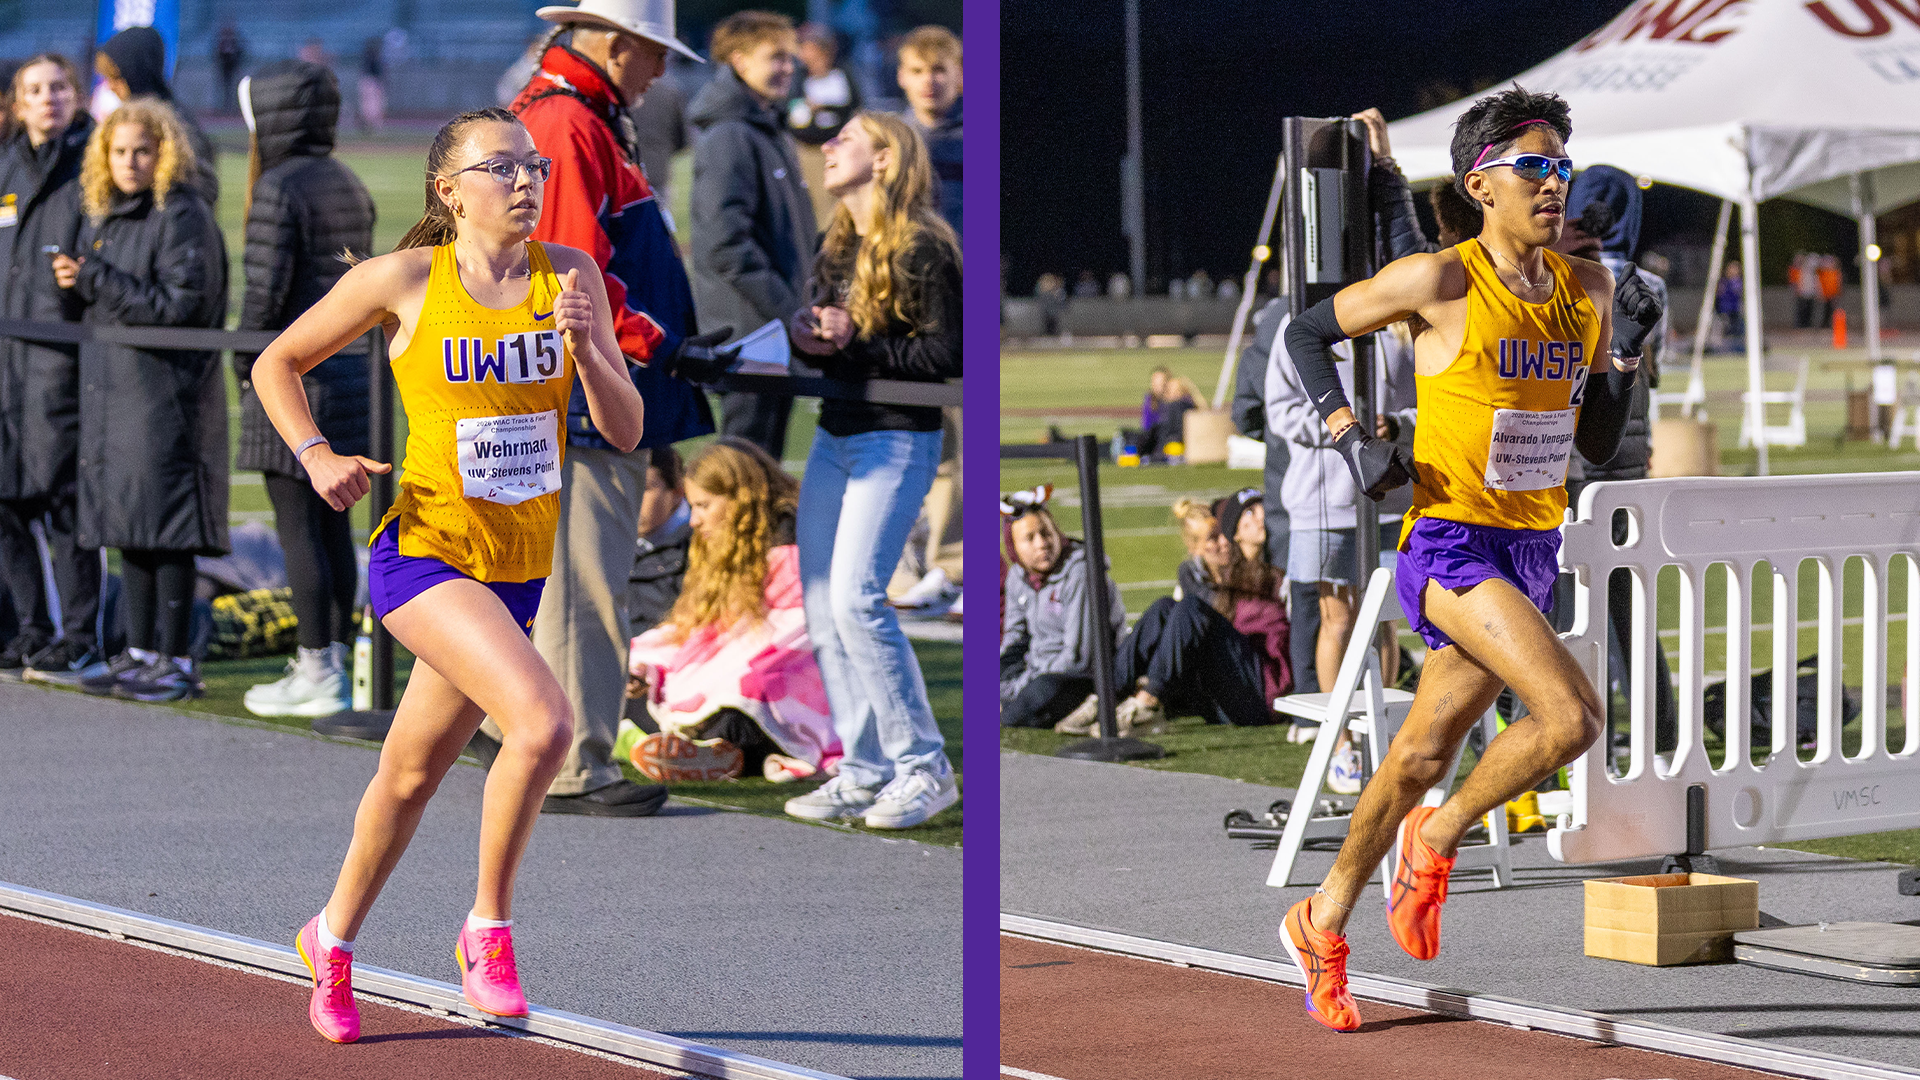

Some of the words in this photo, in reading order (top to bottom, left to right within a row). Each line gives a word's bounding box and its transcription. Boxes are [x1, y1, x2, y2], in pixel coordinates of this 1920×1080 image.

[510, 332, 558, 379] 15
[1498, 338, 1584, 381] UWSP
[492, 418, 511, 426] WIAC
[535, 414, 547, 422] Field
[490, 424, 537, 434] Championships
[1493, 431, 1538, 445] Alvarado
[1541, 432, 1573, 445] Venegas
[473, 438, 548, 459] Wehrman
[1495, 452, 1548, 465] UW-Stevens
[1548, 451, 1567, 463] Point
[534, 460, 555, 475] Point
[1832, 784, 1881, 810] VMSC
